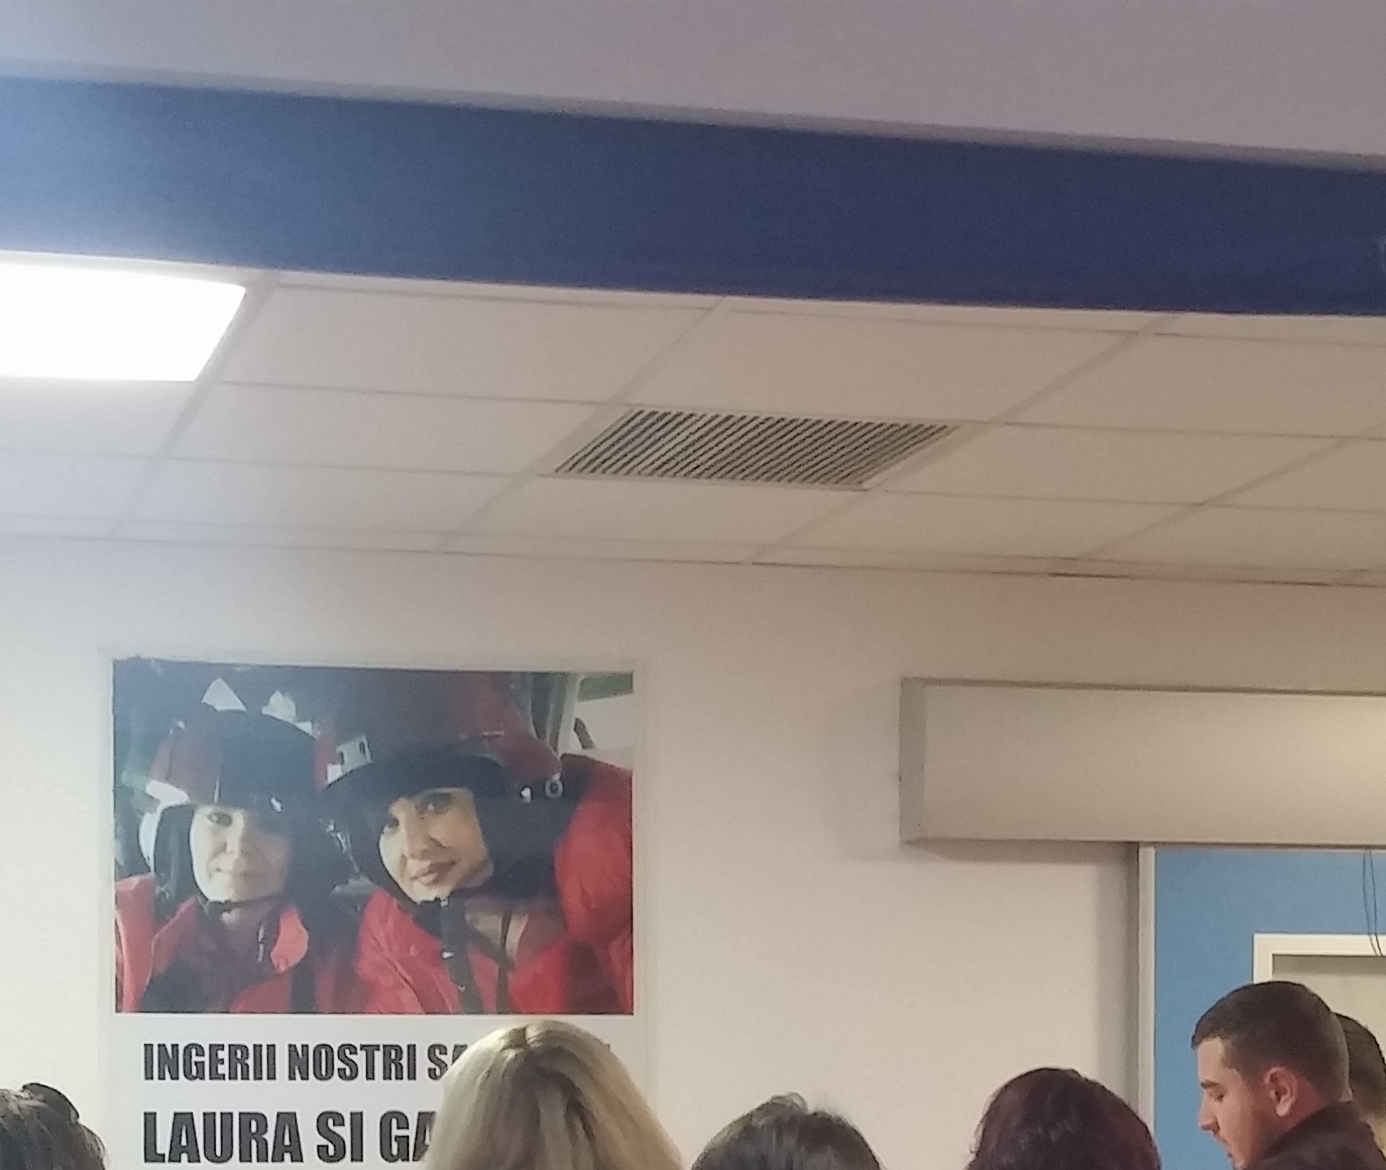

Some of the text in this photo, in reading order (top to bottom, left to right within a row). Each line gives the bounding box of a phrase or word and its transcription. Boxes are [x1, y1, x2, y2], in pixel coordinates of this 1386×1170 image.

[144, 1043, 277, 1081] INGERII
[288, 1043, 417, 1081] NOSTRI
[144, 1111, 305, 1164] LAURA
[317, 1110, 364, 1164] SI
